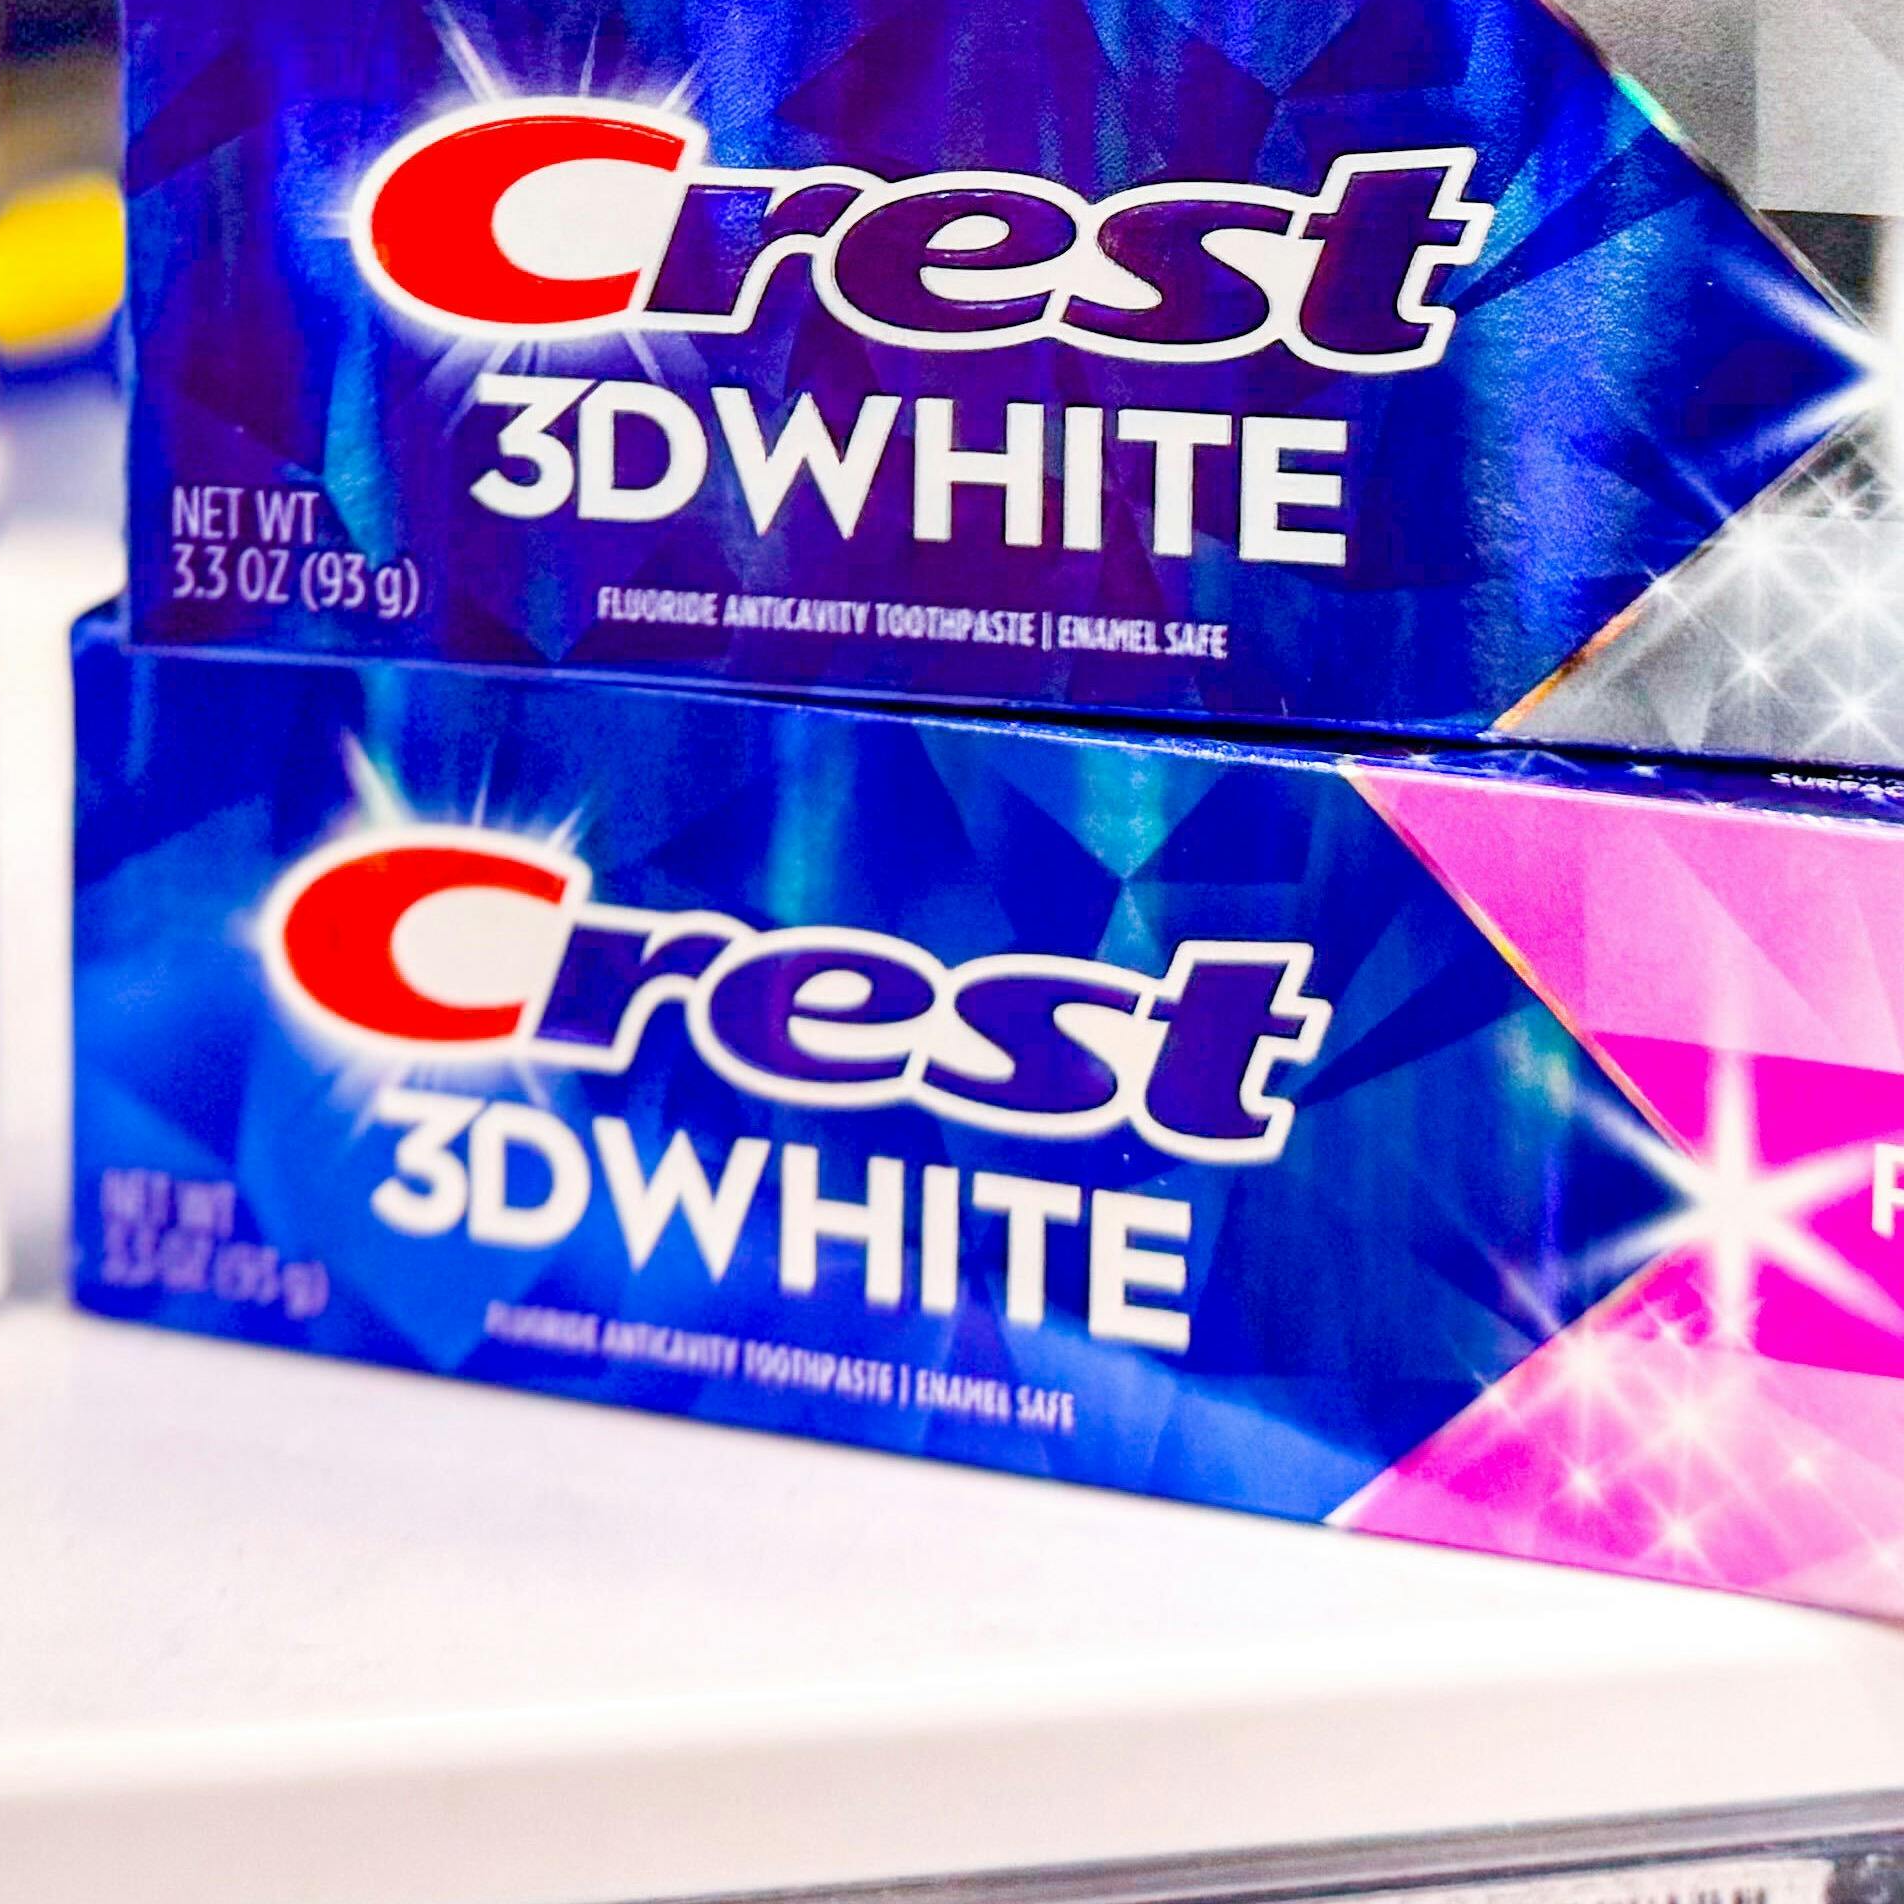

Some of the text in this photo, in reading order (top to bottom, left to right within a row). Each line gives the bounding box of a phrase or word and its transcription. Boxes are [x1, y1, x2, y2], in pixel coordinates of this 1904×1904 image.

[358, 102, 1492, 368] Crest
[171, 485, 321, 544] NET WT
[171, 542, 420, 619] 3.3 OZ (93 g)
[596, 585, 1229, 660] FLUORIDE ANTICAVITY TOOTHPASTE ENAMEL SAFE
[274, 834, 1326, 1154] Crest
[743, 1338, 894, 1402] TOOTHPASTE
[914, 1364, 1013, 1421] ENAMEL
[1014, 1386, 1077, 1434] SAFE
